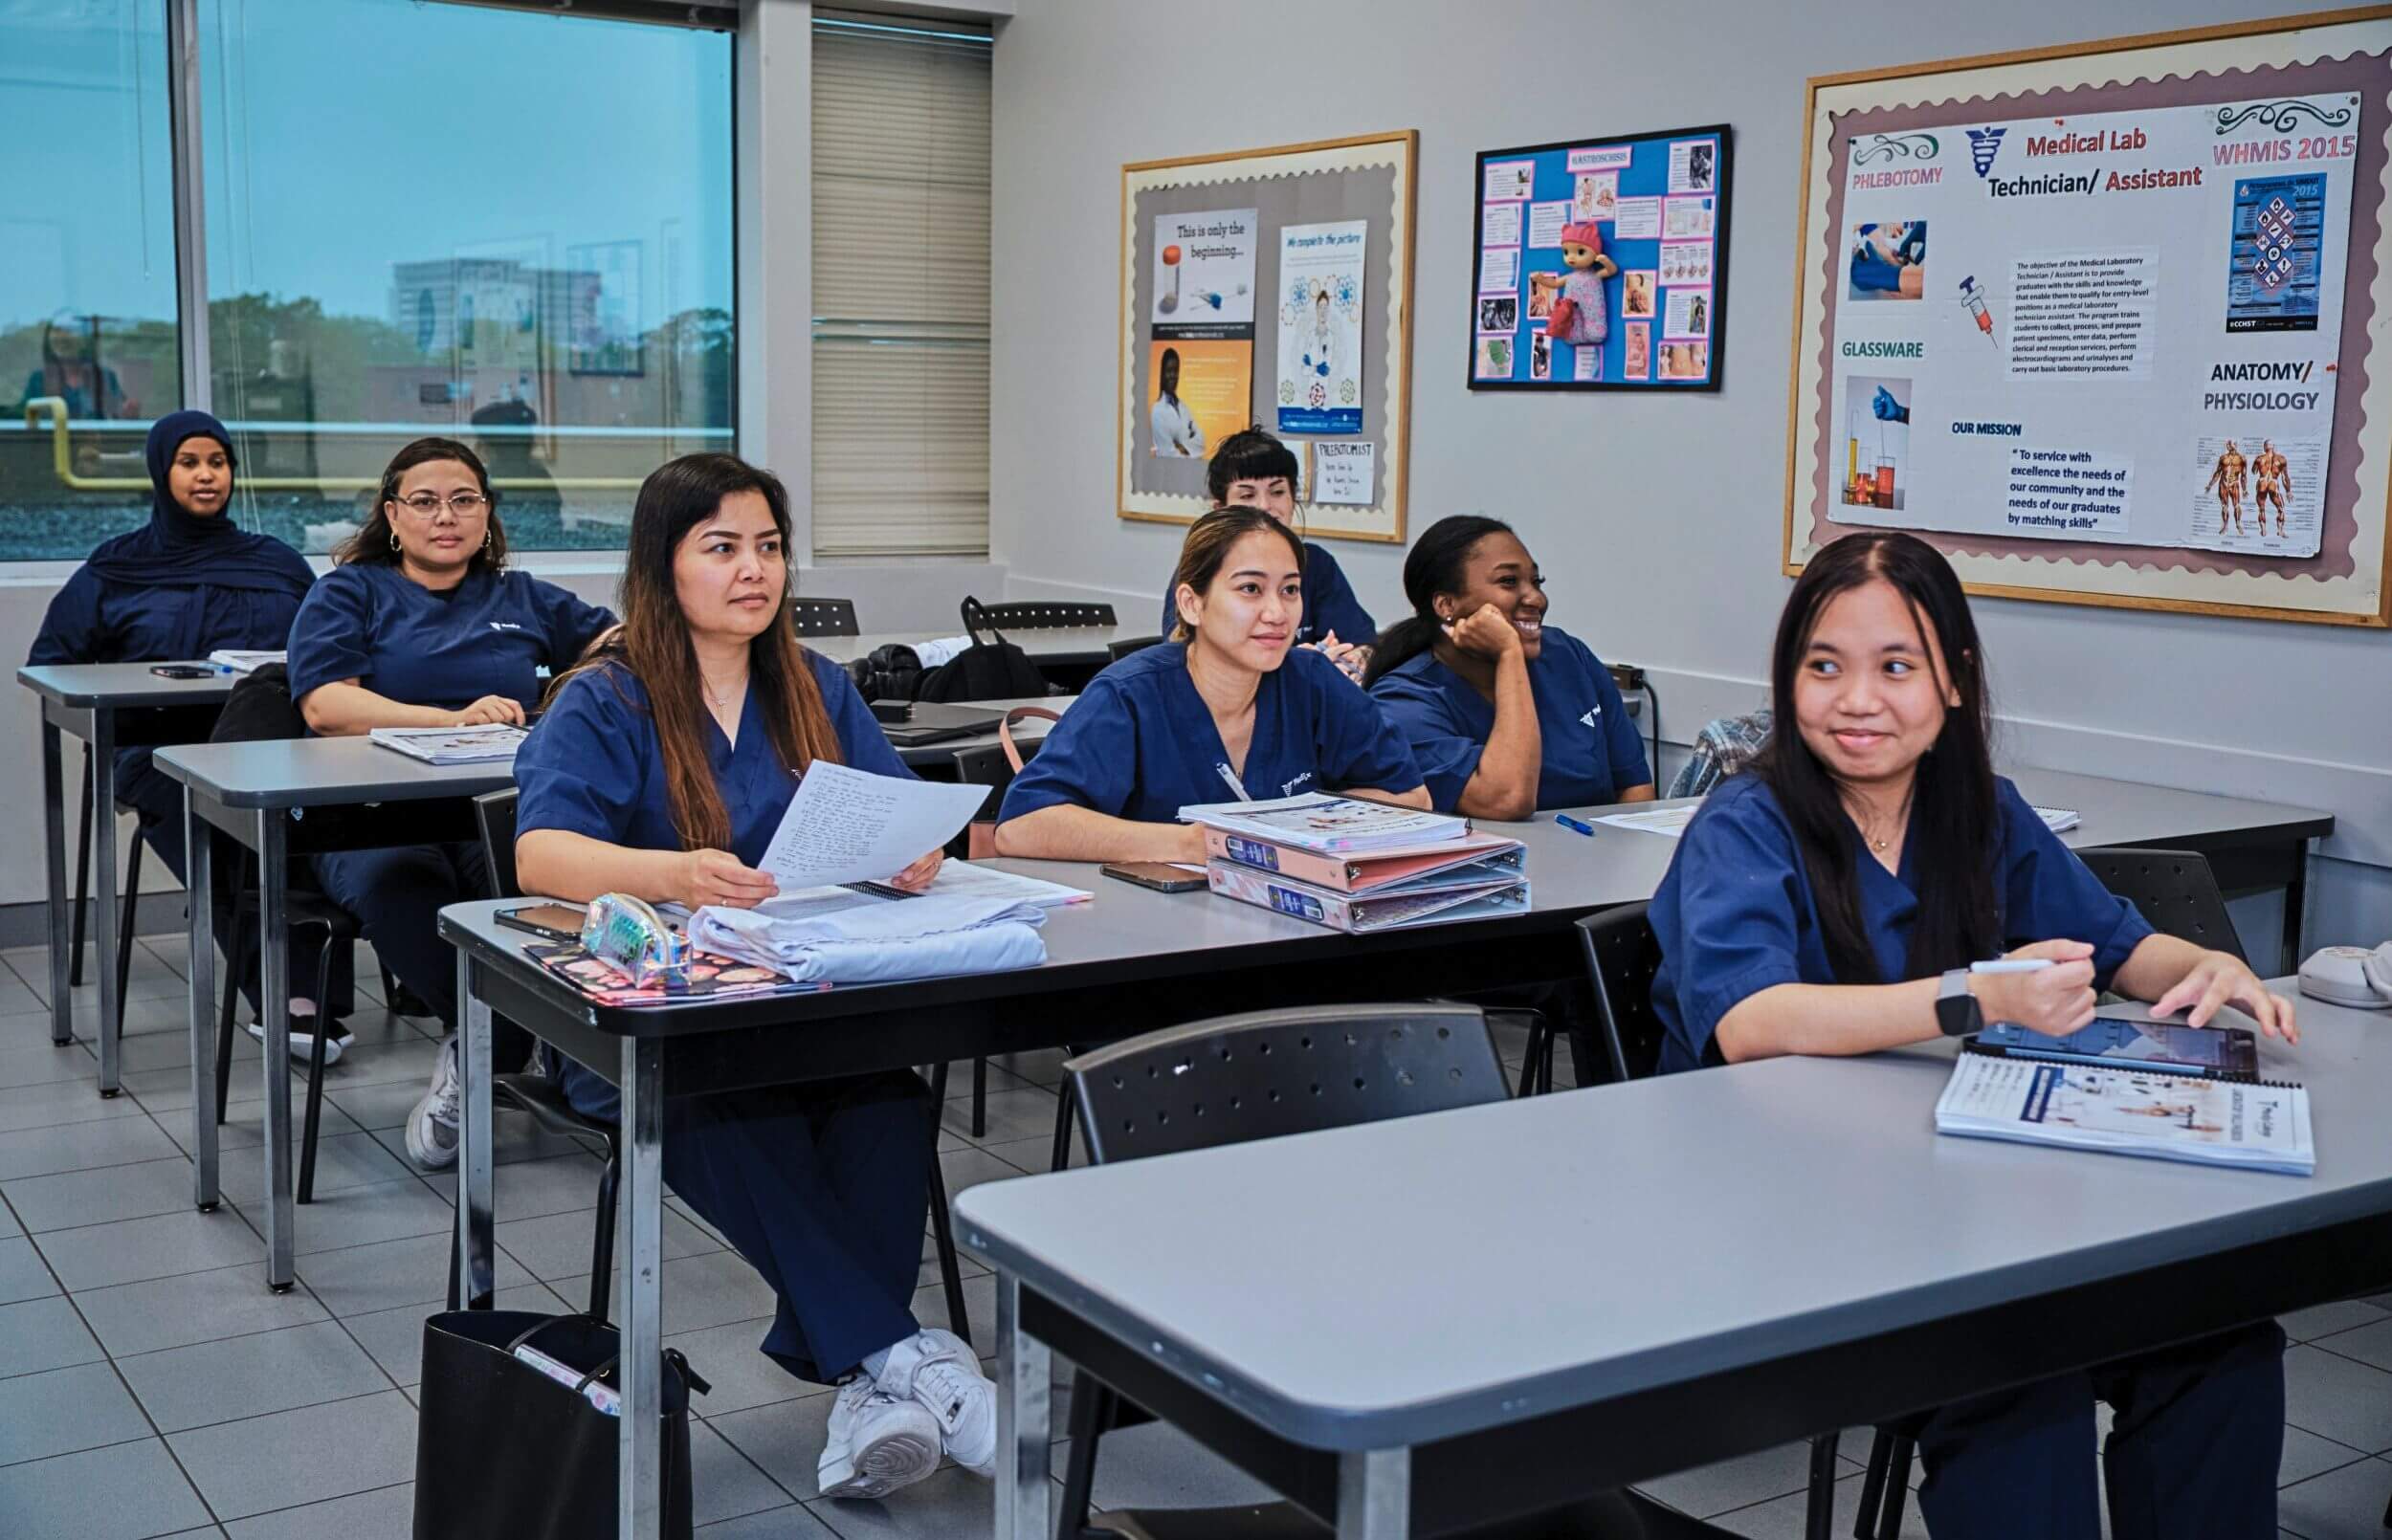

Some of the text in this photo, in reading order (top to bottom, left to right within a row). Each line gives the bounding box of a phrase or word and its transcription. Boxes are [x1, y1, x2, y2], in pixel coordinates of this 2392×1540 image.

[2027, 128, 2146, 155] Medical Lab
[2214, 135, 2355, 165] WHMIS 2015
[1853, 167, 1942, 189] PHLEBOTOMY
[1988, 166, 2202, 197] Technician/ Assistant
[2293, 185, 2318, 196] 2015
[1178, 220, 1244, 238] This is only the
[1325, 233, 1336, 245] the
[1336, 232, 1361, 247] picture
[2079, 291, 2100, 299] qualify
[2113, 289, 2148, 297] entry-level
[2073, 323, 2099, 332] process,
[1843, 342, 1923, 358] GLASSWARE
[2087, 354, 2118, 363] urinalyses
[2211, 361, 2314, 384] ANATOMY/
[2204, 392, 2319, 409] PHYSIOLOGY
[1952, 422, 2022, 436] OUR MISSION
[2020, 450, 2030, 460] To
[2033, 451, 2067, 461] service
[2070, 452, 2092, 462] with
[2011, 467, 2126, 481] excellence the needs of
[2029, 483, 2084, 497] community
[2086, 487, 2104, 495] and
[2108, 487, 2124, 497] the
[2009, 498, 2037, 508] needs
[2040, 499, 2049, 509] of
[2071, 503, 2120, 514] graduates
[2008, 513, 2020, 524] by
[2023, 516, 2066, 529] matching
